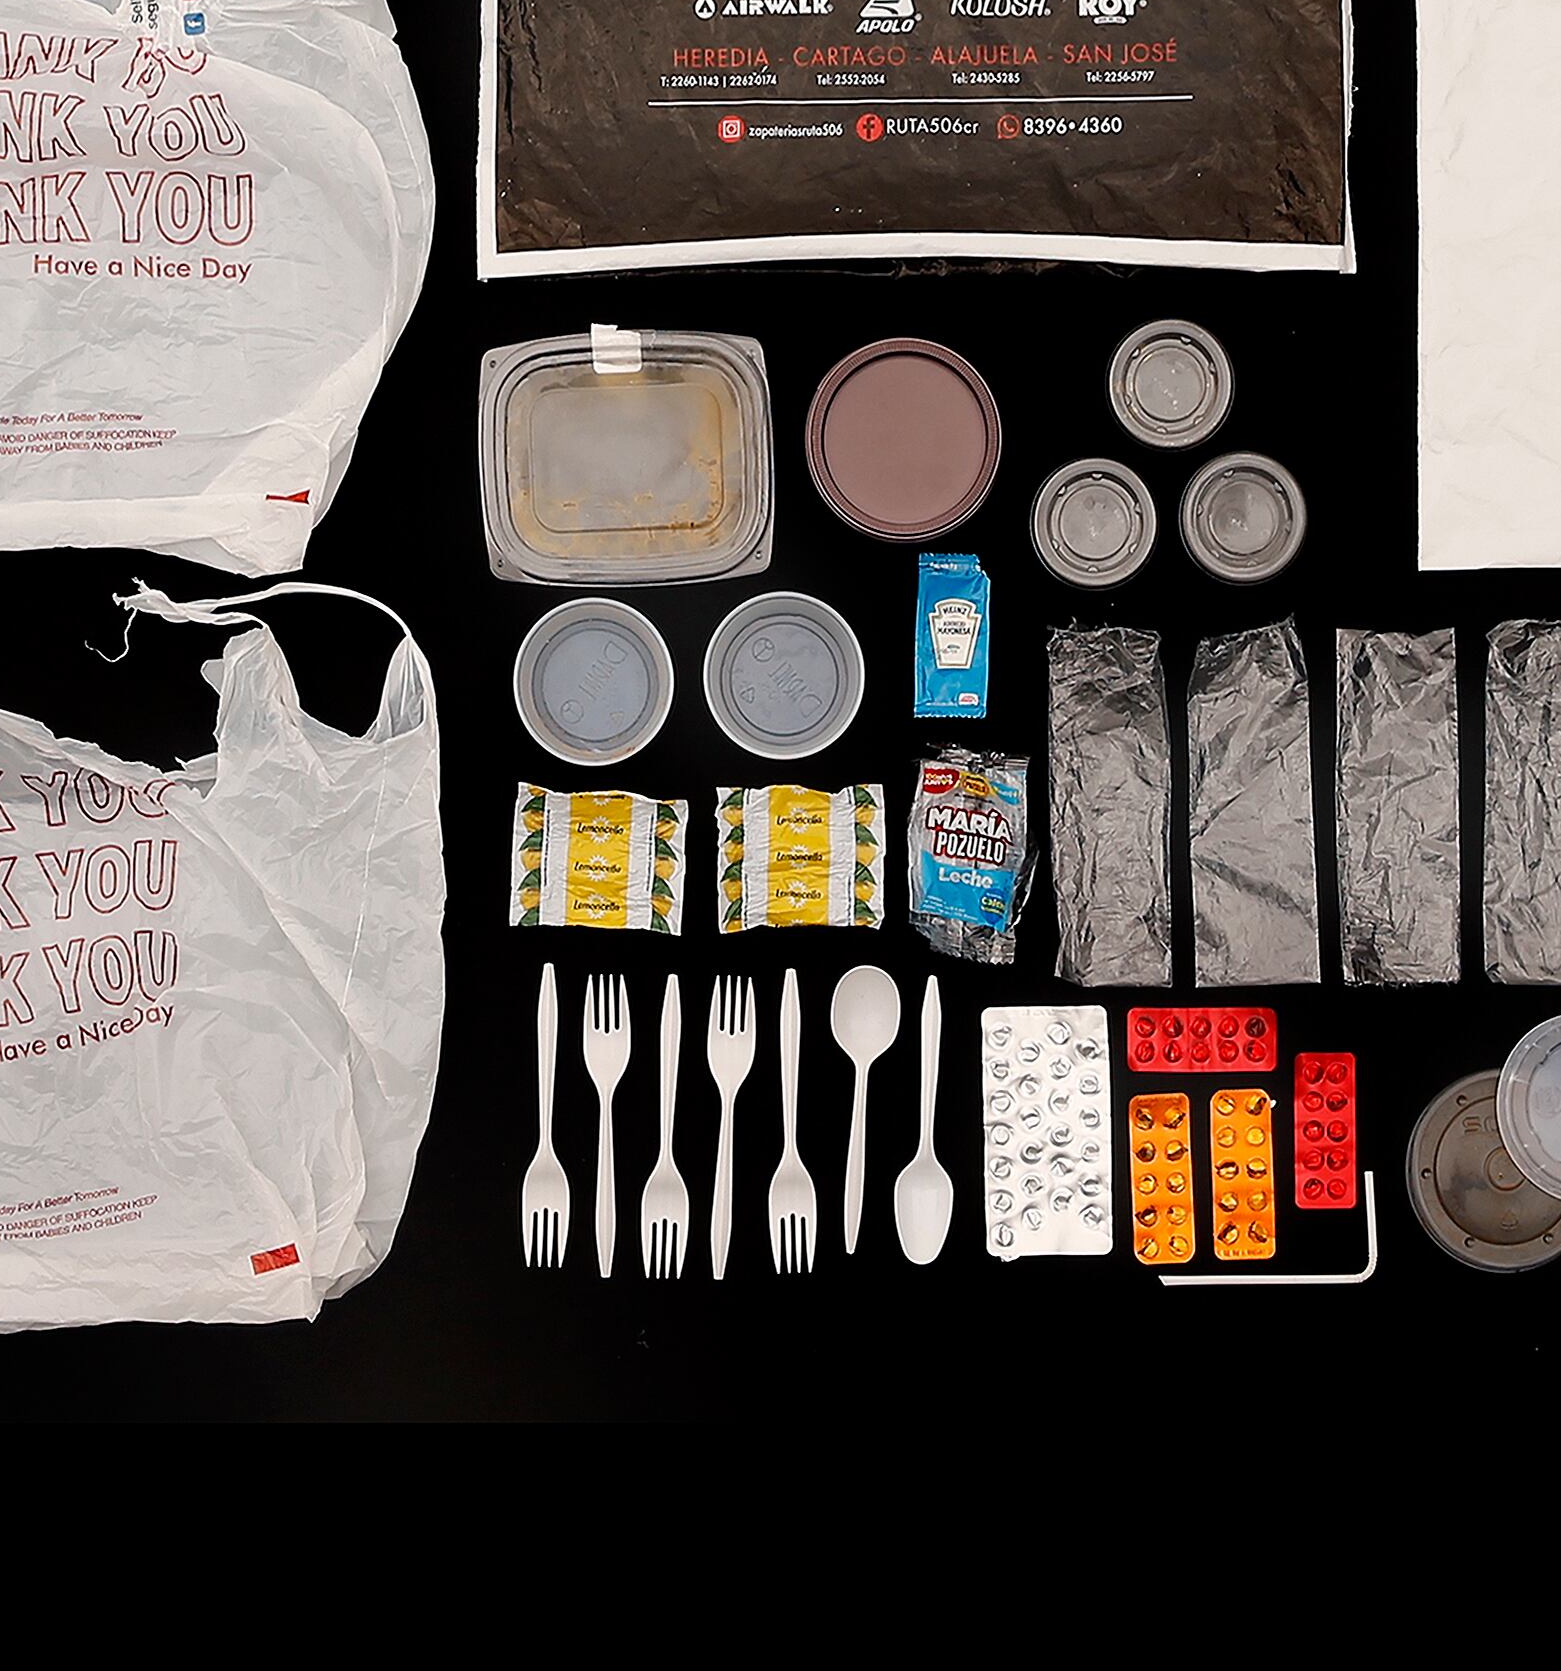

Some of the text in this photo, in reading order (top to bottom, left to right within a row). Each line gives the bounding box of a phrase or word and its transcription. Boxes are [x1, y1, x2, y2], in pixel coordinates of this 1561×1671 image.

[856, 19, 915, 33] APOLO
[673, 38, 1177, 68] HEREDIA CARTAGO ALAJUELA SAN JOSÉ
[103, 93, 246, 161] YOU
[886, 117, 979, 135] RUTA506cr
[105, 170, 254, 246] YOU
[34, 254, 252, 284] Have a Nice Day
[577, 823, 625, 835] Lemoncella
[927, 807, 1013, 842] MARÍA
[936, 831, 1006, 864] POZUELO
[36, 840, 178, 919] YOU
[574, 861, 622, 874] Lemoncella
[939, 867, 993, 889] Leche
[42, 930, 178, 1013] YOU
[56, 1032, 73, 1050] a
[79, 1017, 135, 1047] Nice
[74, 1186, 120, 1202] Tomorrow
[6, 1217, 47, 1231] DANGER
[50, 1214, 63, 1225] OF
[64, 1201, 131, 1223] SUFFOCATION
[132, 1195, 158, 1208] KEEP
